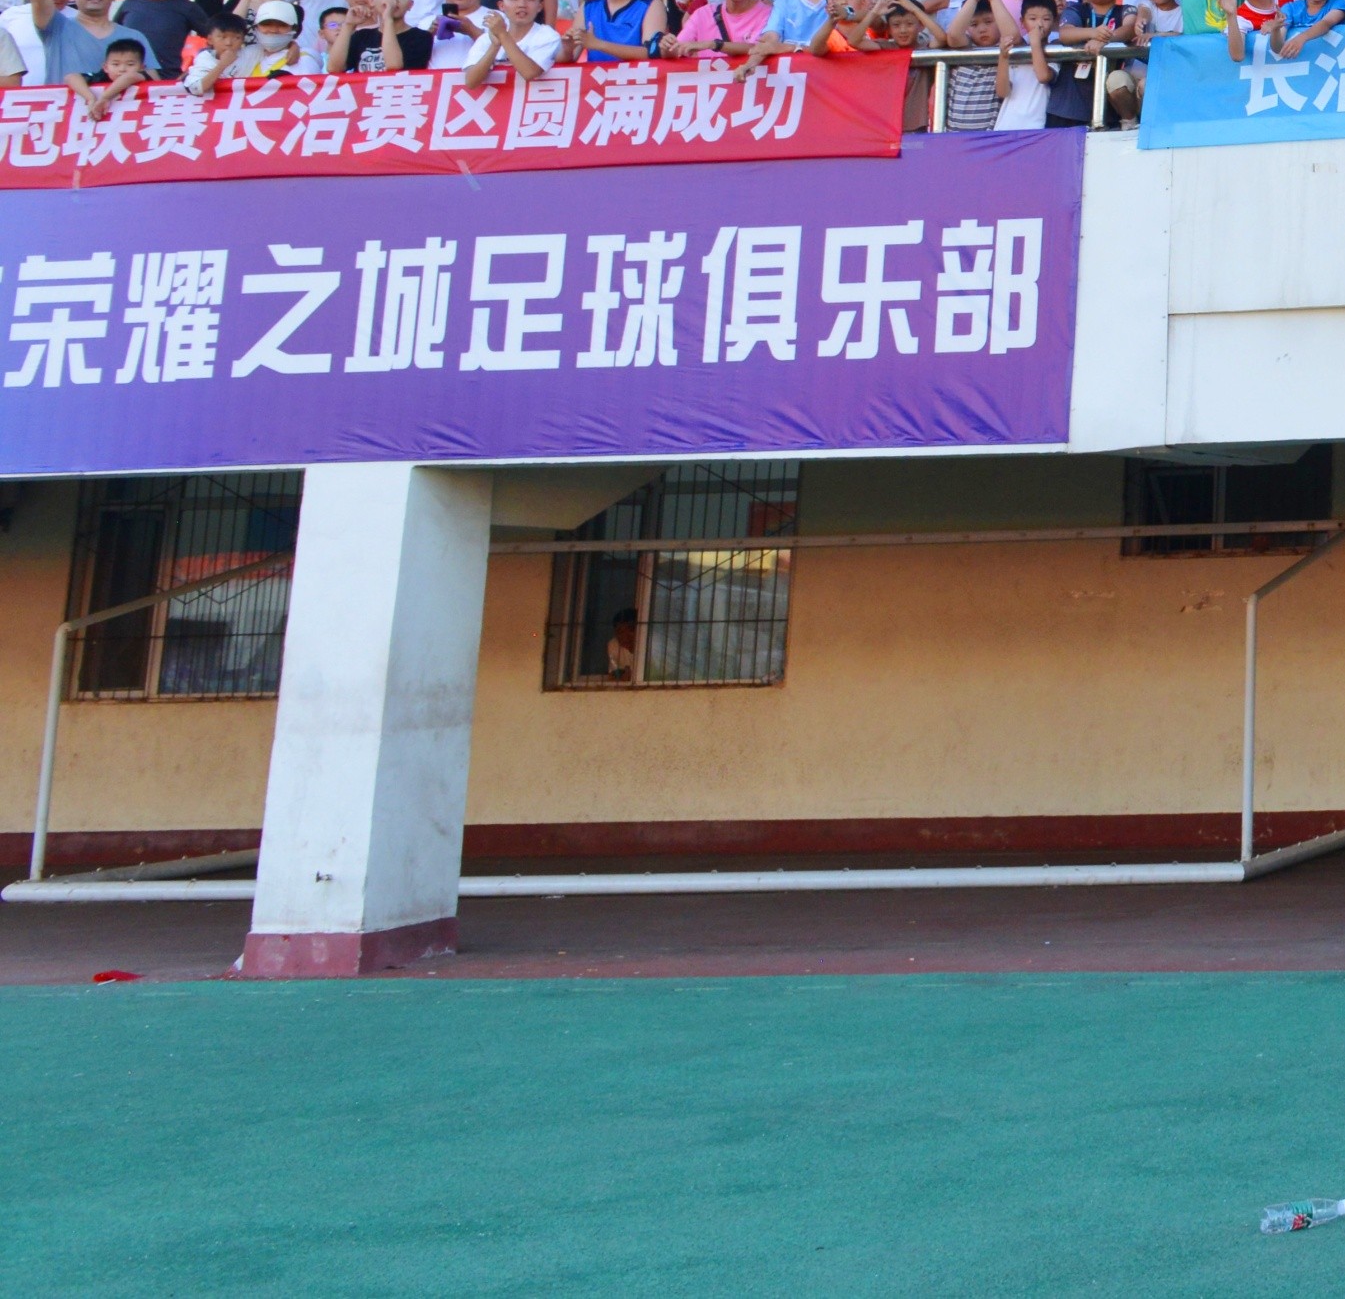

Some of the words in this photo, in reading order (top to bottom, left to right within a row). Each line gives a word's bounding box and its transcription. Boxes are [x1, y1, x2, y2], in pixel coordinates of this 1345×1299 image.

[0, 219, 1042, 387] 荣耀之城足球俱乐部
